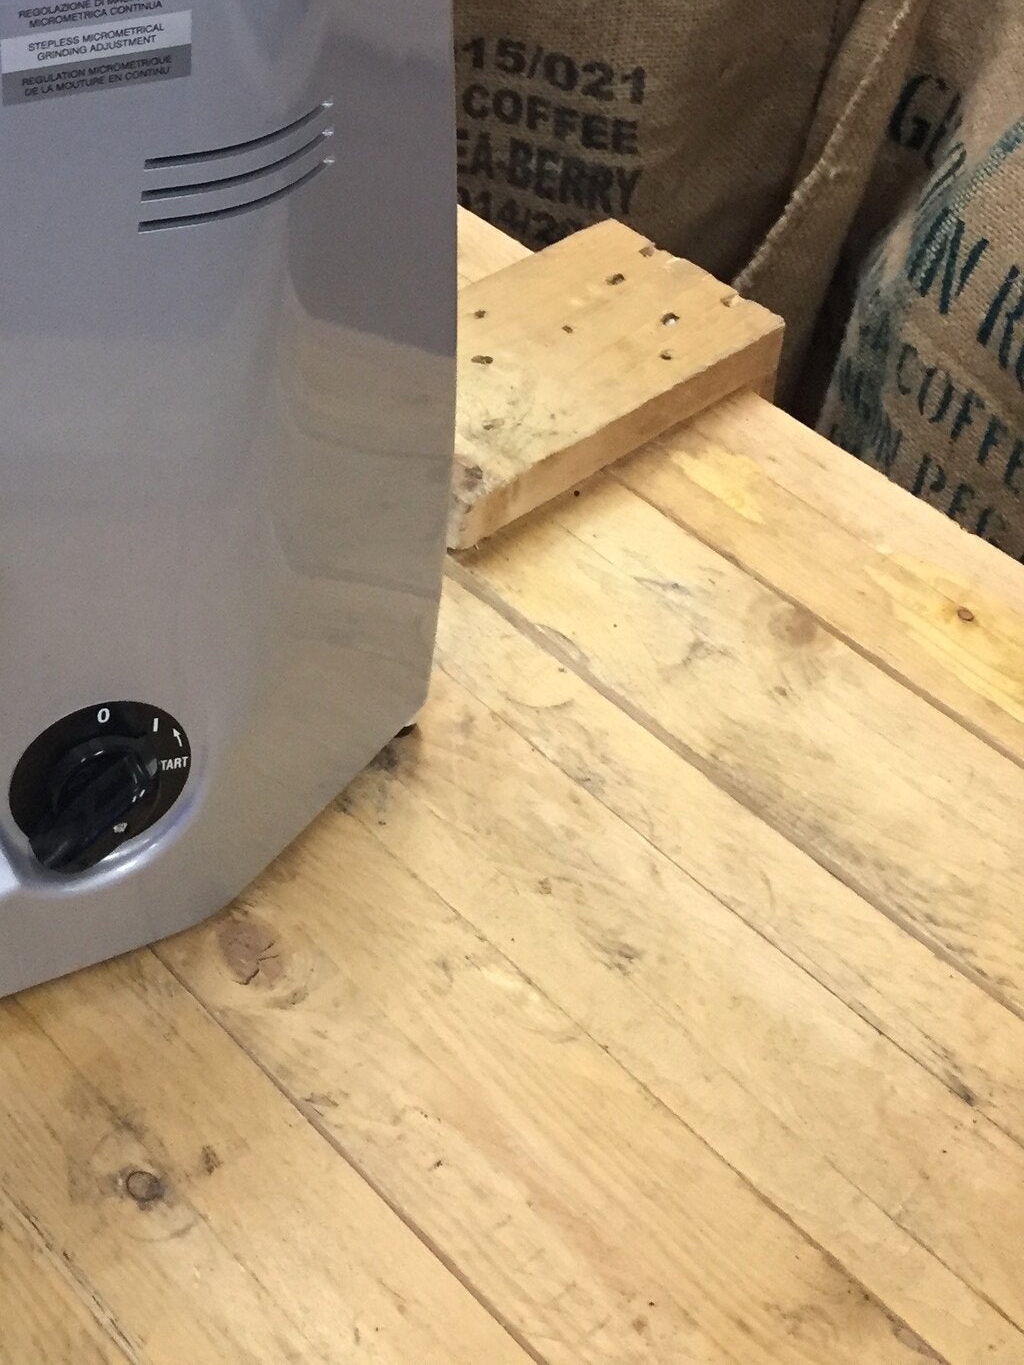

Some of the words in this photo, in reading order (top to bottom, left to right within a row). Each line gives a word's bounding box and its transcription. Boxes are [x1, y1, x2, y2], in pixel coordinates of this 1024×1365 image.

[18, 0, 92, 19] REGOLAZIONE
[29, 8, 109, 28] MICROMETRICA
[109, 0, 164, 16] CONTINUA
[27, 35, 80, 52] STEPLESS
[82, 23, 165, 44] MICROMETRICAL
[36, 44, 88, 61] GRINDING
[89, 34, 157, 53] ADJUSTMENT
[21, 68, 87, 87] REGULATION
[87, 54, 174, 76] MICROMETRIQUE
[24, 86, 39, 97] DE
[41, 84, 55, 94] LA
[55, 75, 106, 91] MOUTURE
[108, 72, 123, 84] EN
[125, 66, 171, 81] CONTINU
[461, 37, 647, 106] 15/021
[461, 84, 640, 156] COFFEE
